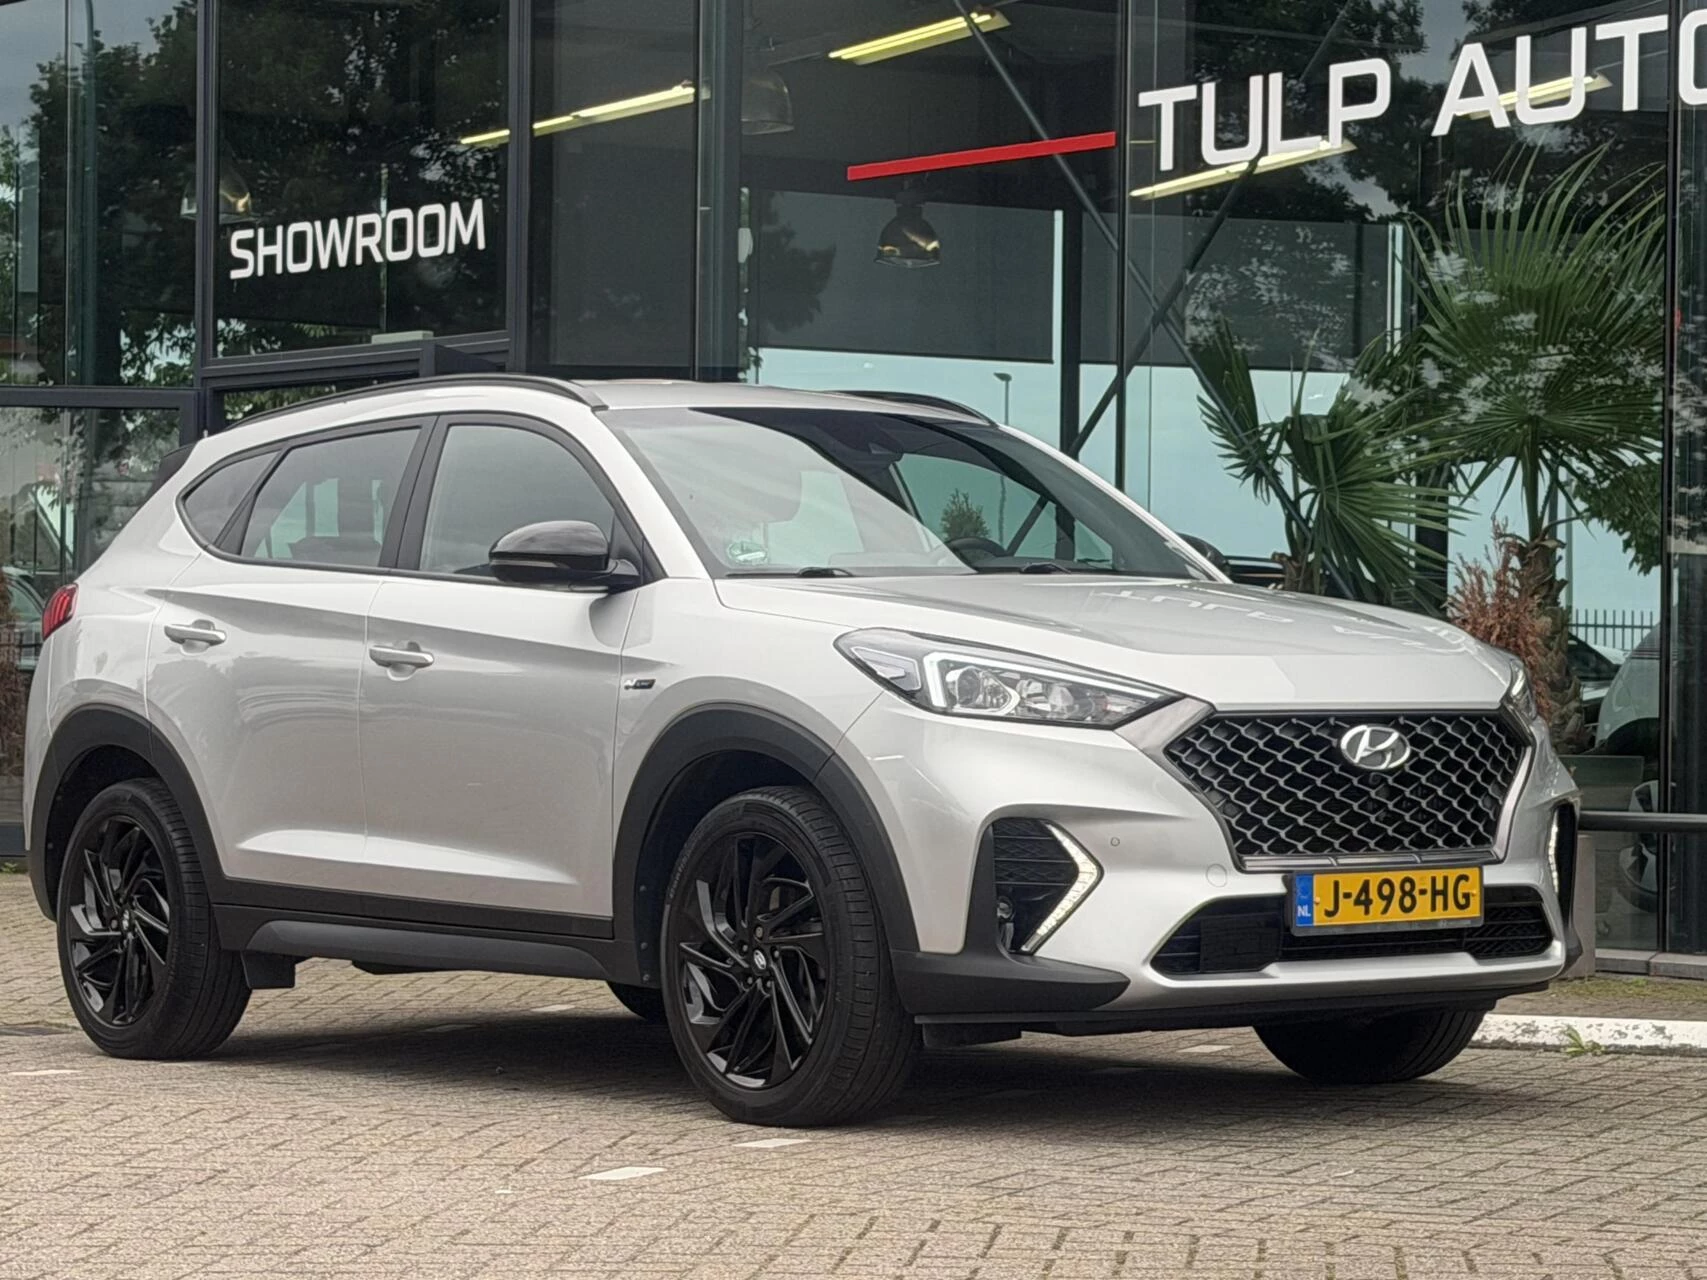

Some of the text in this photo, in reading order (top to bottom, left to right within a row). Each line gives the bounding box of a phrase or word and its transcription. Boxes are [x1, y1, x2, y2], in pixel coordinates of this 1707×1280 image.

[1138, 57, 1391, 172] TULP
[229, 198, 486, 280] SHOWROOM
[1297, 904, 1311, 917] NL
[1324, 873, 1471, 918] J-498-HG
